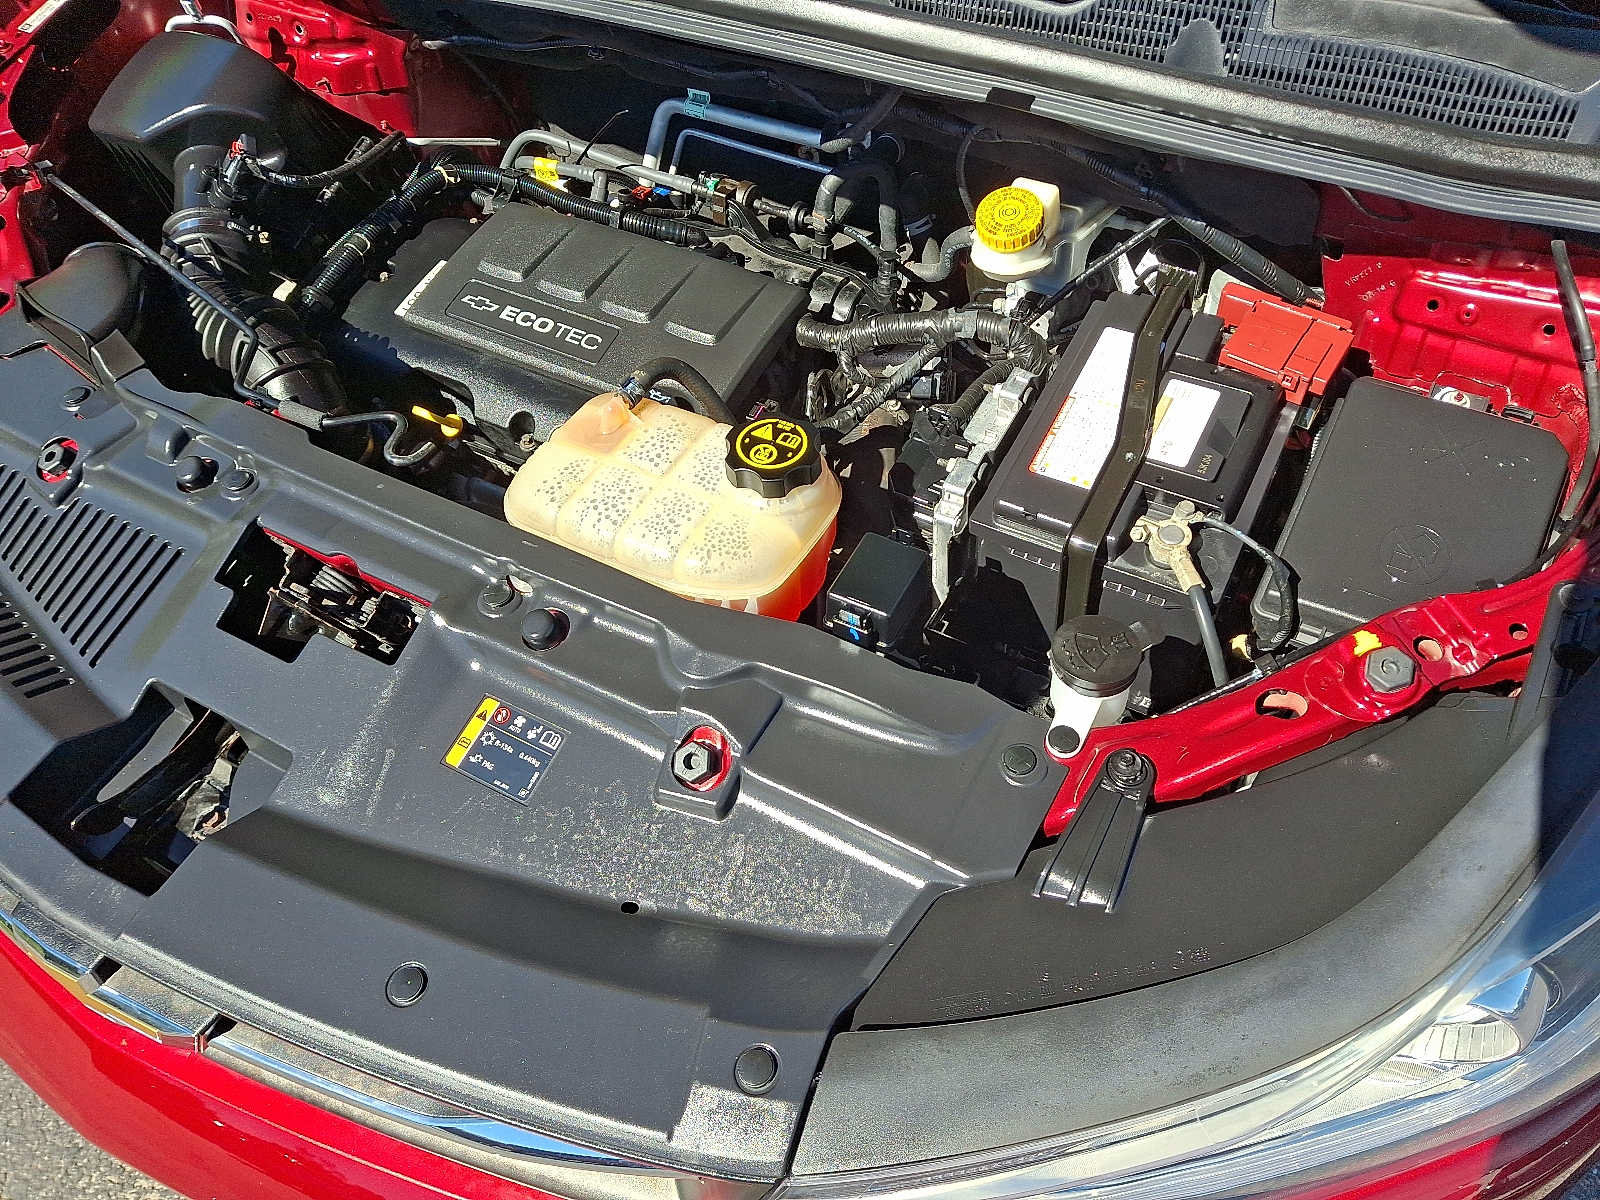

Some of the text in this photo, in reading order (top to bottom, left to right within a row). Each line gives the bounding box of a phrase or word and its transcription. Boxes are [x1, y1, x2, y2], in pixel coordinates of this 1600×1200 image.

[498, 304, 603, 351] ECOTEC
[508, 725, 521, 734] AUTO
[494, 740, 514, 754] R-134a
[481, 759, 495, 771] PAG
